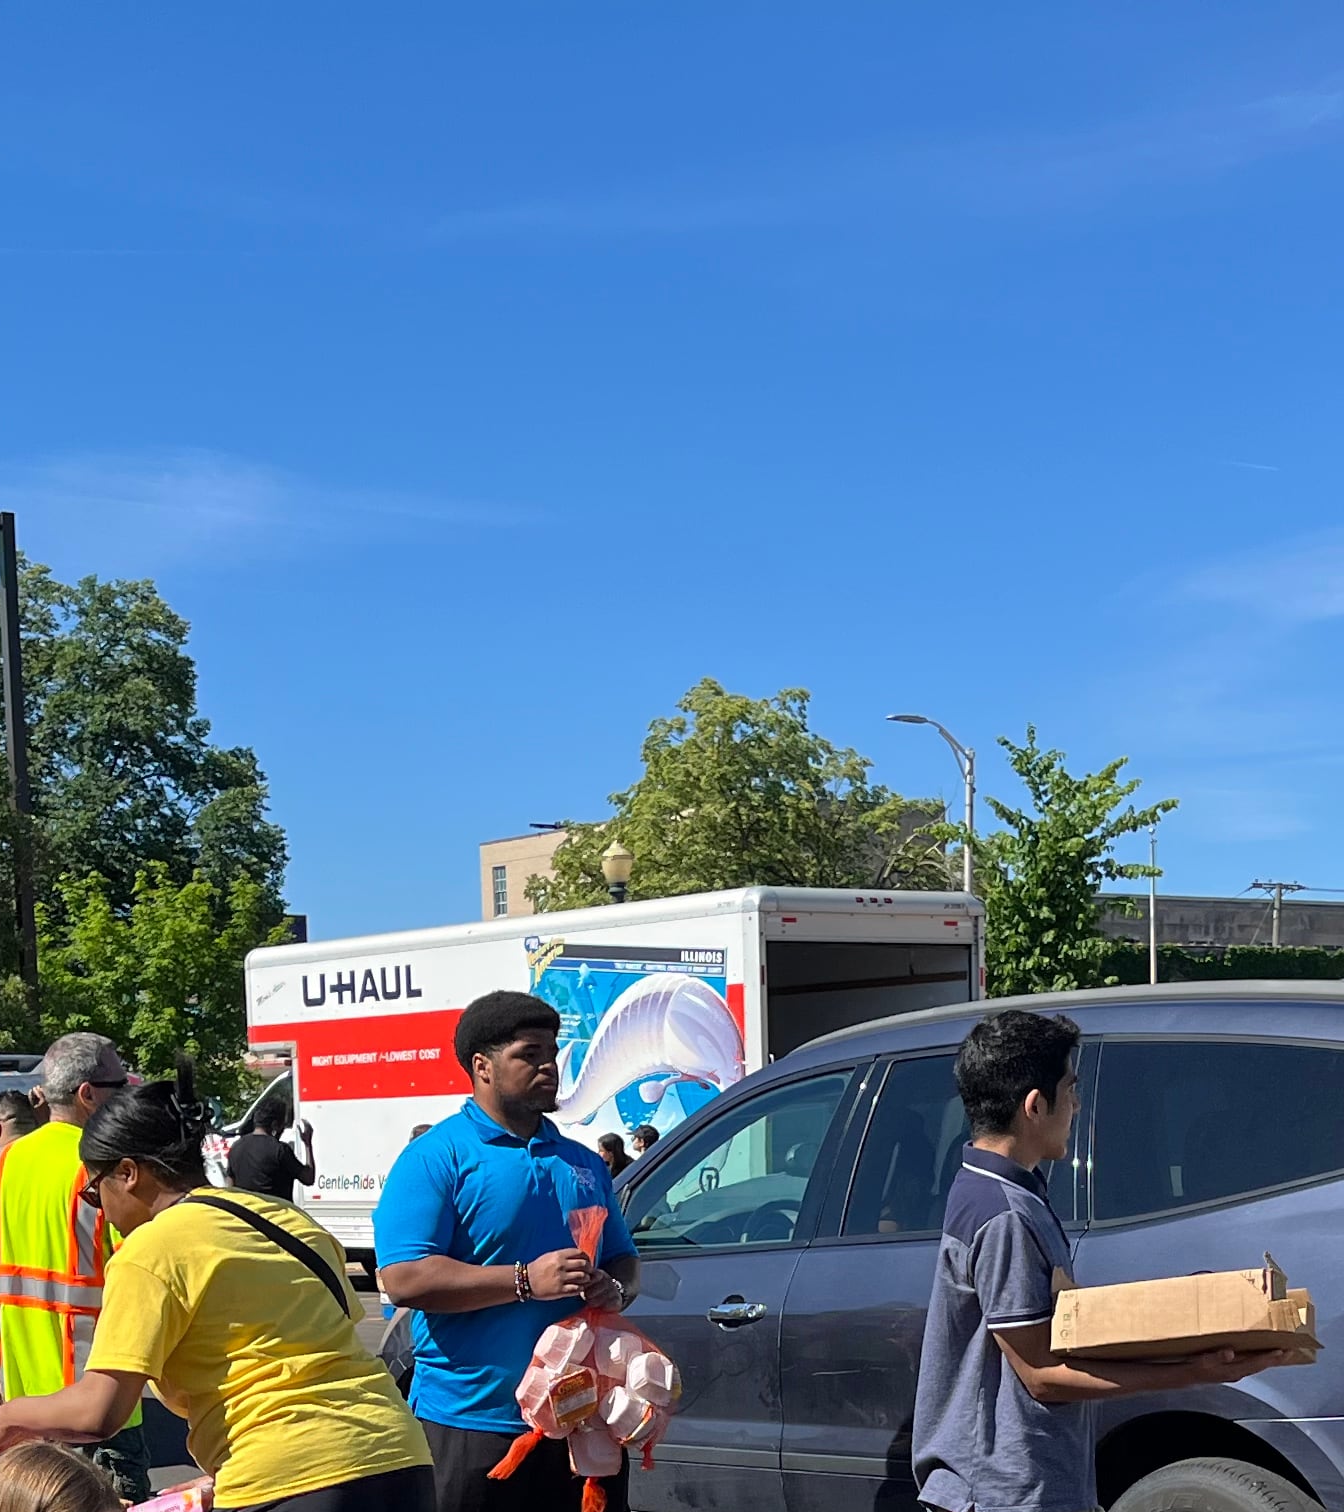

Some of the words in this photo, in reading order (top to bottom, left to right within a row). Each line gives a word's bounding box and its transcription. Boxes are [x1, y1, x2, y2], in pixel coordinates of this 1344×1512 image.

[681, 951, 723, 963] ILLINOIS
[302, 965, 422, 1007] U-HAUL
[312, 1055, 332, 1066] RIGHT
[334, 1052, 377, 1065] EQUIPMENT
[419, 1049, 440, 1060] COST
[318, 1174, 375, 1189] Gentle-Ride
